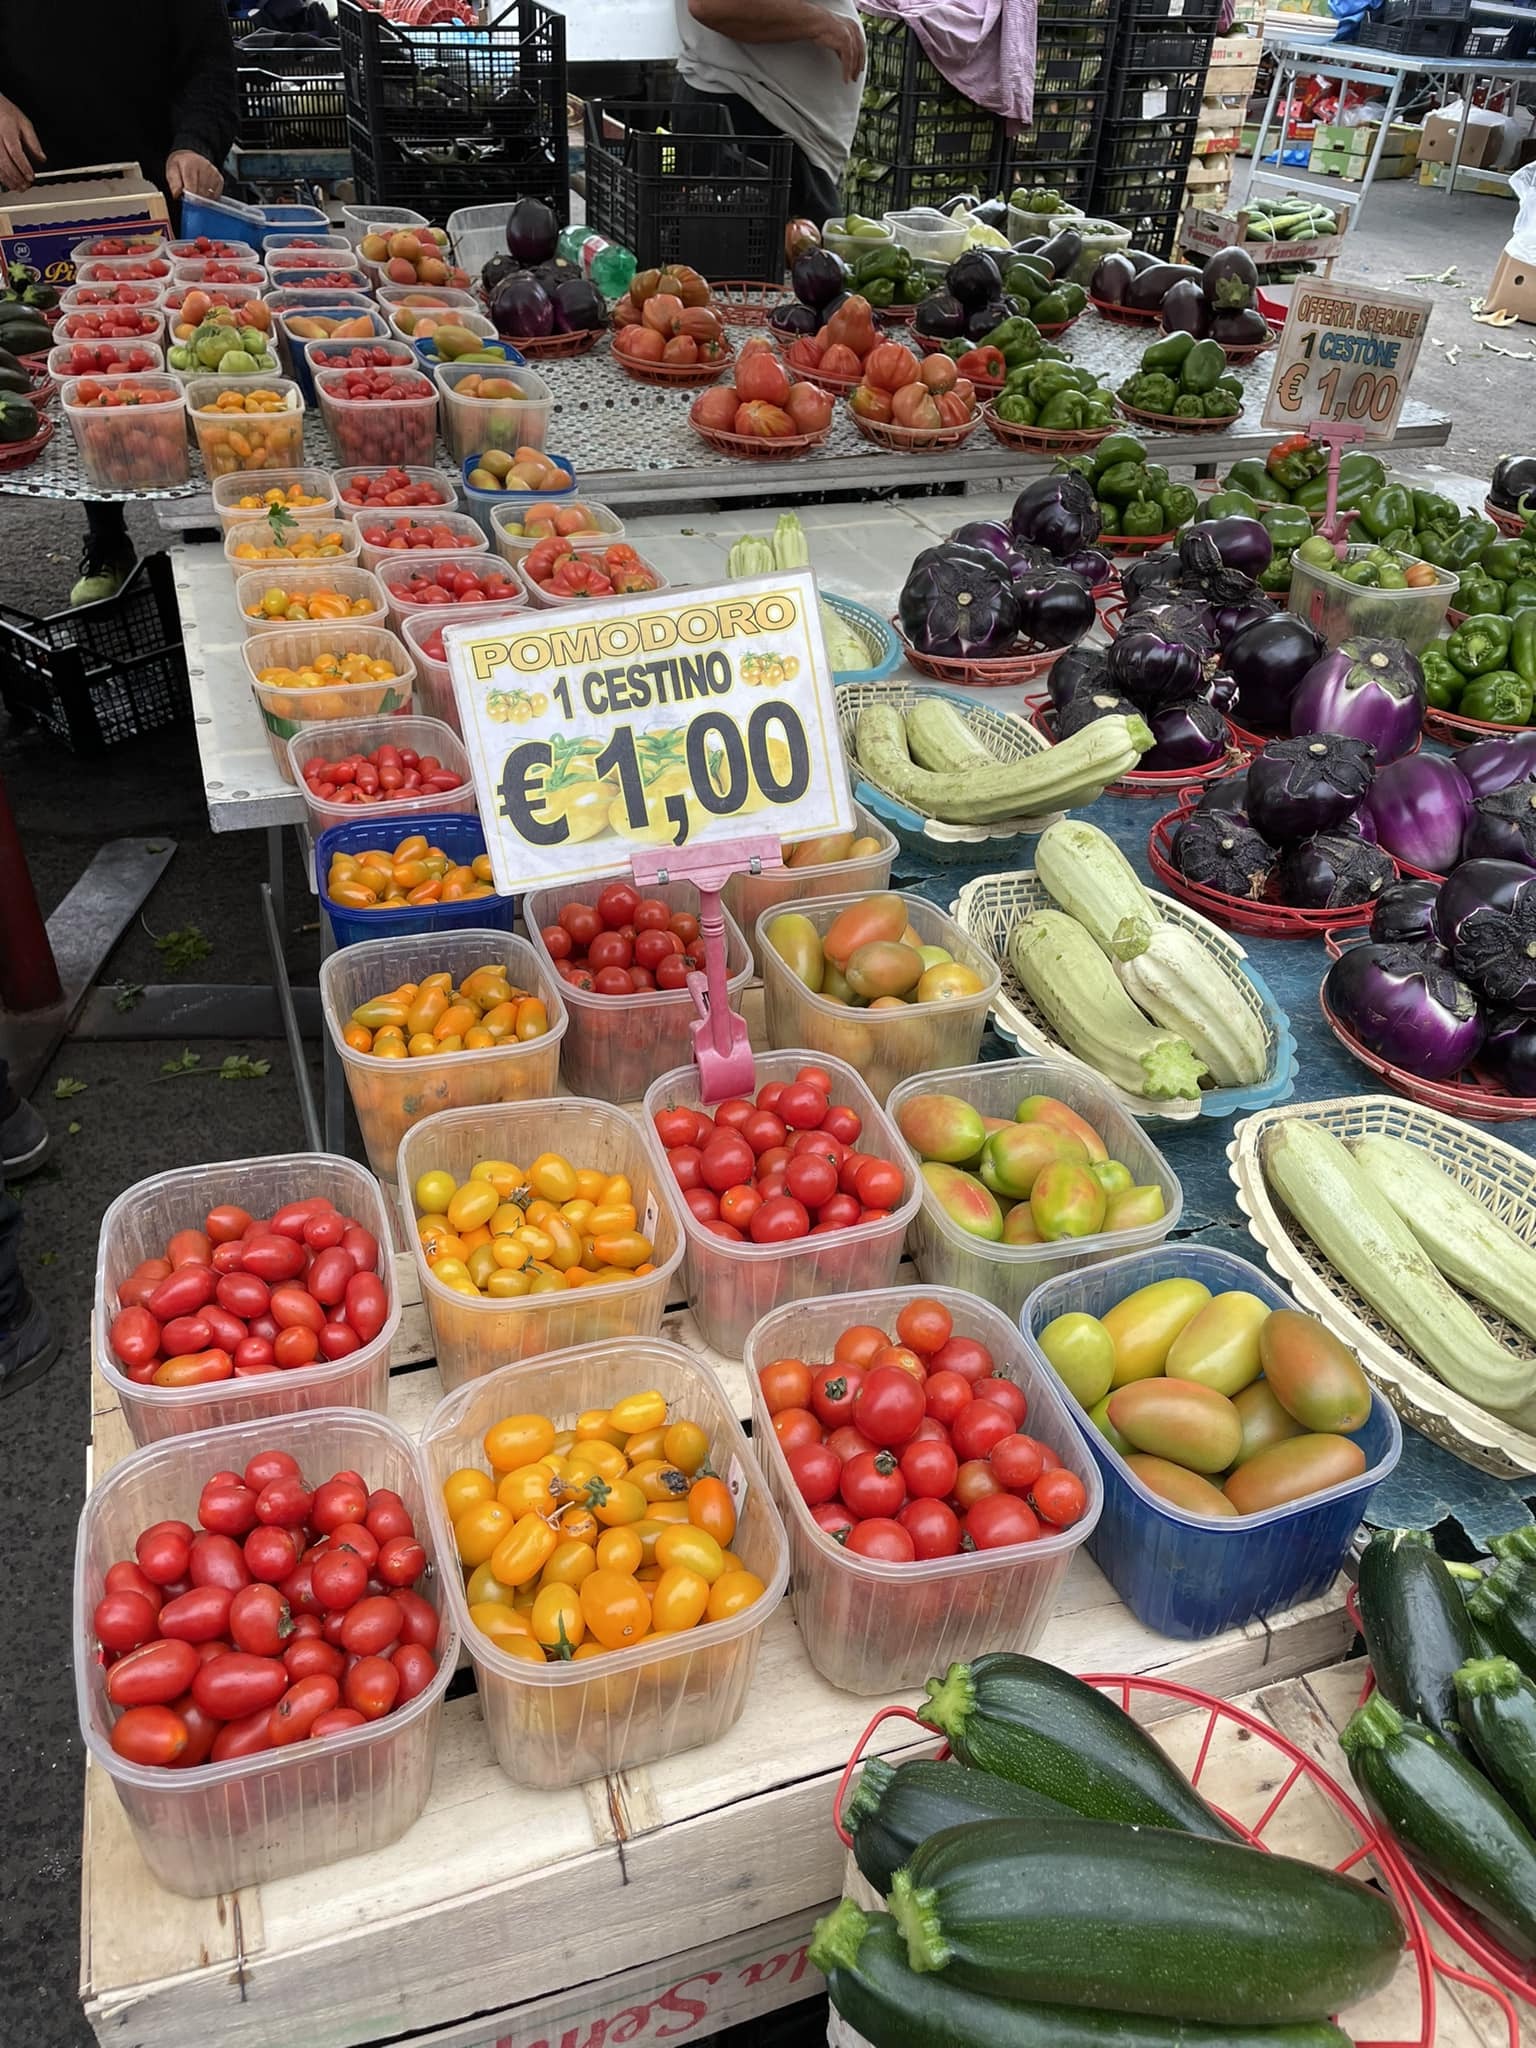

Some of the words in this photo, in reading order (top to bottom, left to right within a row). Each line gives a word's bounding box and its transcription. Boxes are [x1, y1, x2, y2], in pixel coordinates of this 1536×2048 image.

[1187, 227, 1228, 248] Faustino
[1264, 245, 1318, 260] Faustino
[44, 261, 76, 284] Pi
[1297, 295, 1357, 329] OFFERTA
[1357, 304, 1420, 338] SPECIALE
[1301, 329, 1319, 358] 1
[1319, 332, 1401, 368] CESTONE
[1277, 363, 1309, 411] €
[1317, 367, 1398, 422] 1,00
[471, 596, 796, 680] POMODORO
[553, 676, 574, 720] 1
[582, 650, 732, 716] CESTINO
[497, 741, 570, 846] €
[595, 701, 810, 846] 1,00
